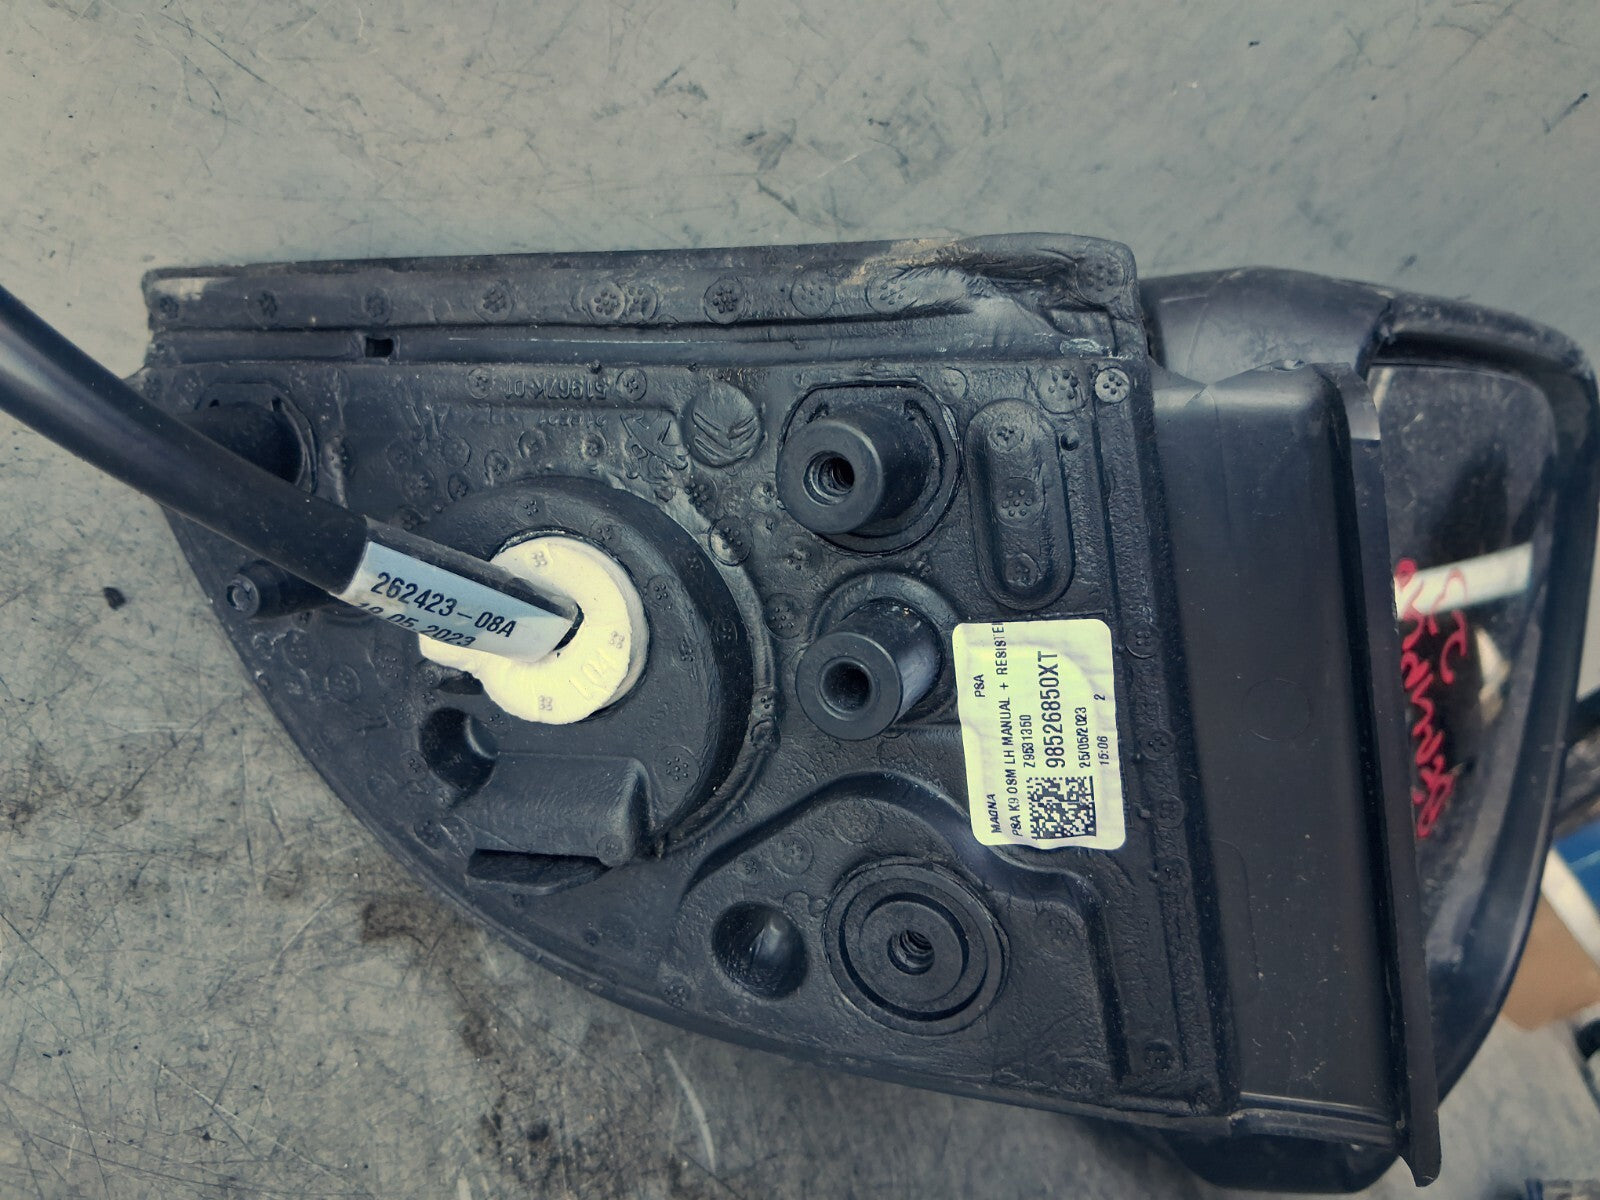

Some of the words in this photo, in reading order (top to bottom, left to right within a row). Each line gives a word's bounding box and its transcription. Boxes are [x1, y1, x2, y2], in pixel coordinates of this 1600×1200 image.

[370, 571, 517, 638] 262423-08A
[973, 673, 986, 698] PSA
[999, 681, 1009, 690] +
[1093, 693, 1106, 701] 2
[999, 697, 1014, 747] MANUAL
[1037, 650, 1066, 769] 98526850XT
[1074, 706, 1091, 769] 25/05/2023
[1003, 750, 1016, 765] LH
[1096, 735, 1110, 766] 15:06
[1007, 796, 1021, 812] K9
[1009, 814, 1023, 837] PSA
